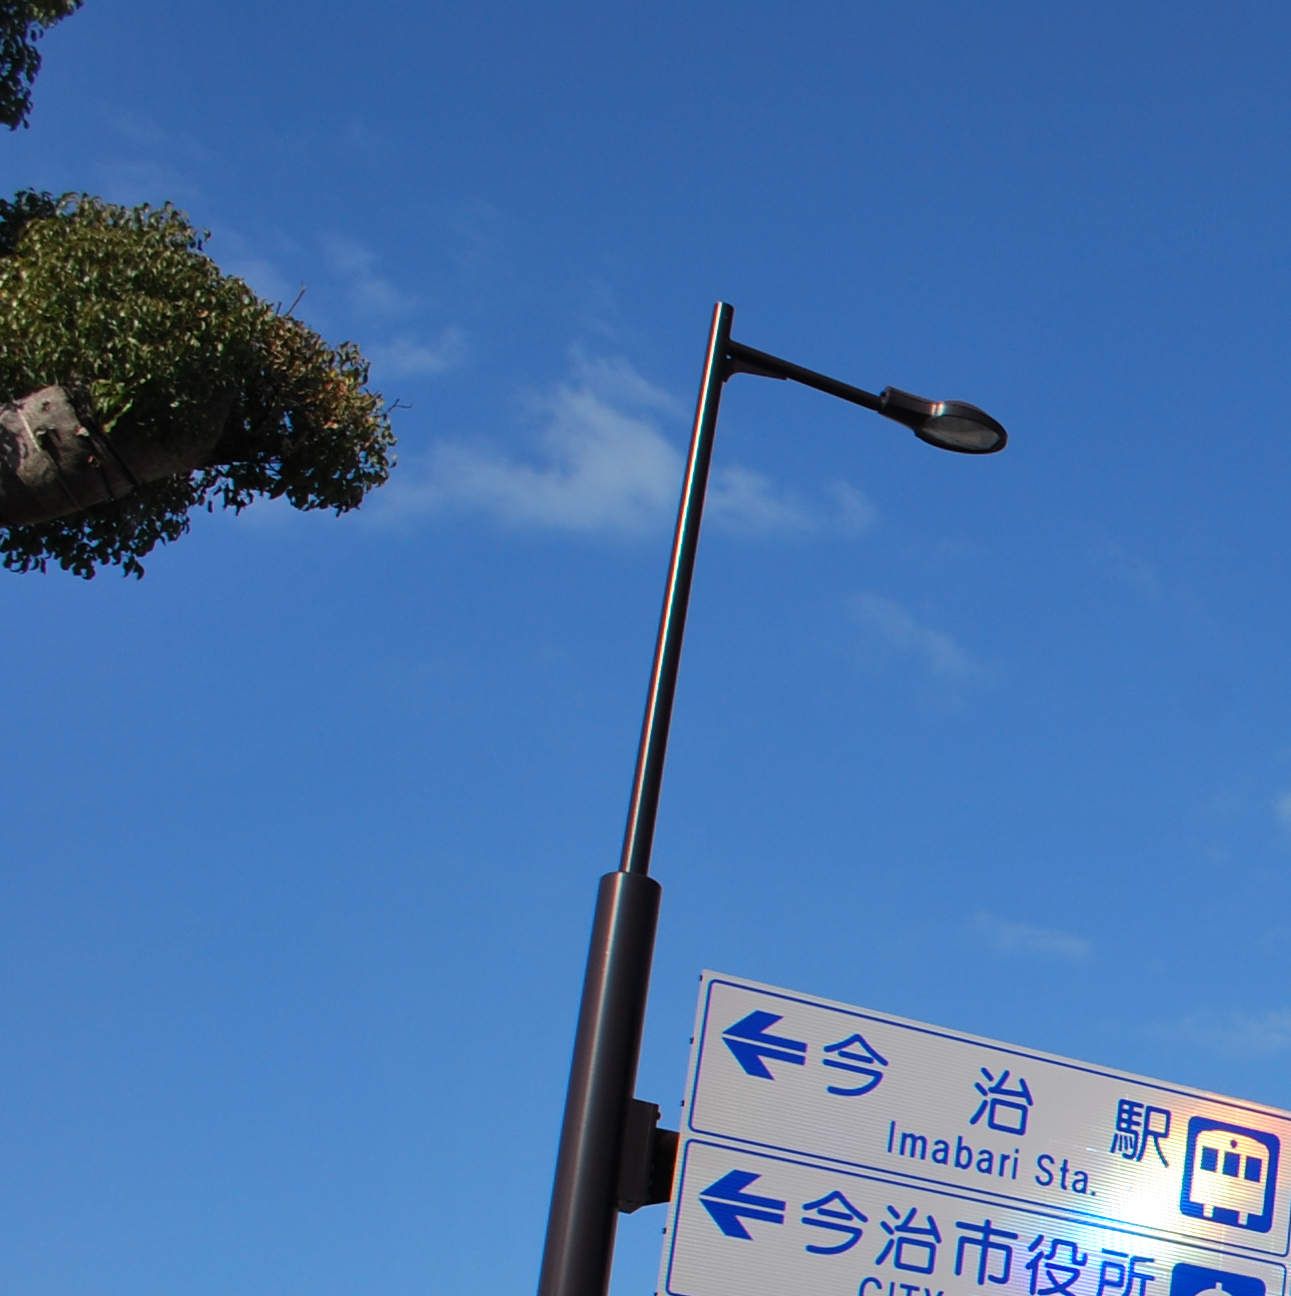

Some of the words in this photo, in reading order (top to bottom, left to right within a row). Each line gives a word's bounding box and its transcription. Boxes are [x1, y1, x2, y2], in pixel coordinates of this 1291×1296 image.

[822, 1033, 1171, 1168] 今治駅
[887, 1120, 1020, 1180] Imabari
[1034, 1155, 1098, 1197] Sta.
